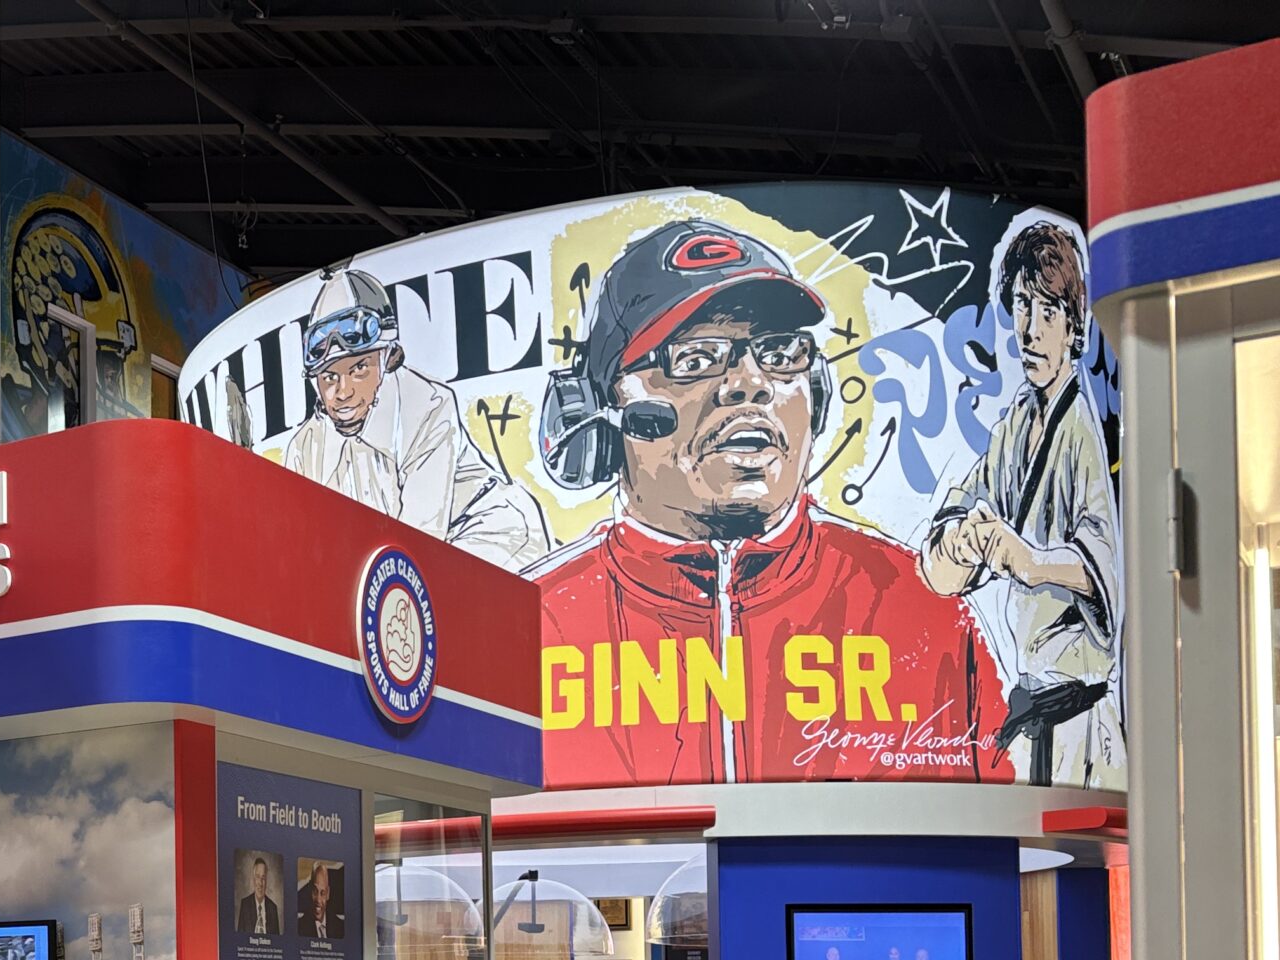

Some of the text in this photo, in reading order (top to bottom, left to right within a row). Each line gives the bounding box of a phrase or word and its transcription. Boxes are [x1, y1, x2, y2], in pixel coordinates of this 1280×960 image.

[180, 250, 543, 441] WHTE
[367, 557, 434, 636] GREATER CLEVELAND
[366, 631, 435, 712] SPORTS HALL OF FAME
[542, 632, 918, 736] GINN SR.
[880, 752, 971, 770] @gvartwork
[236, 796, 342, 834] From Field to Booth
